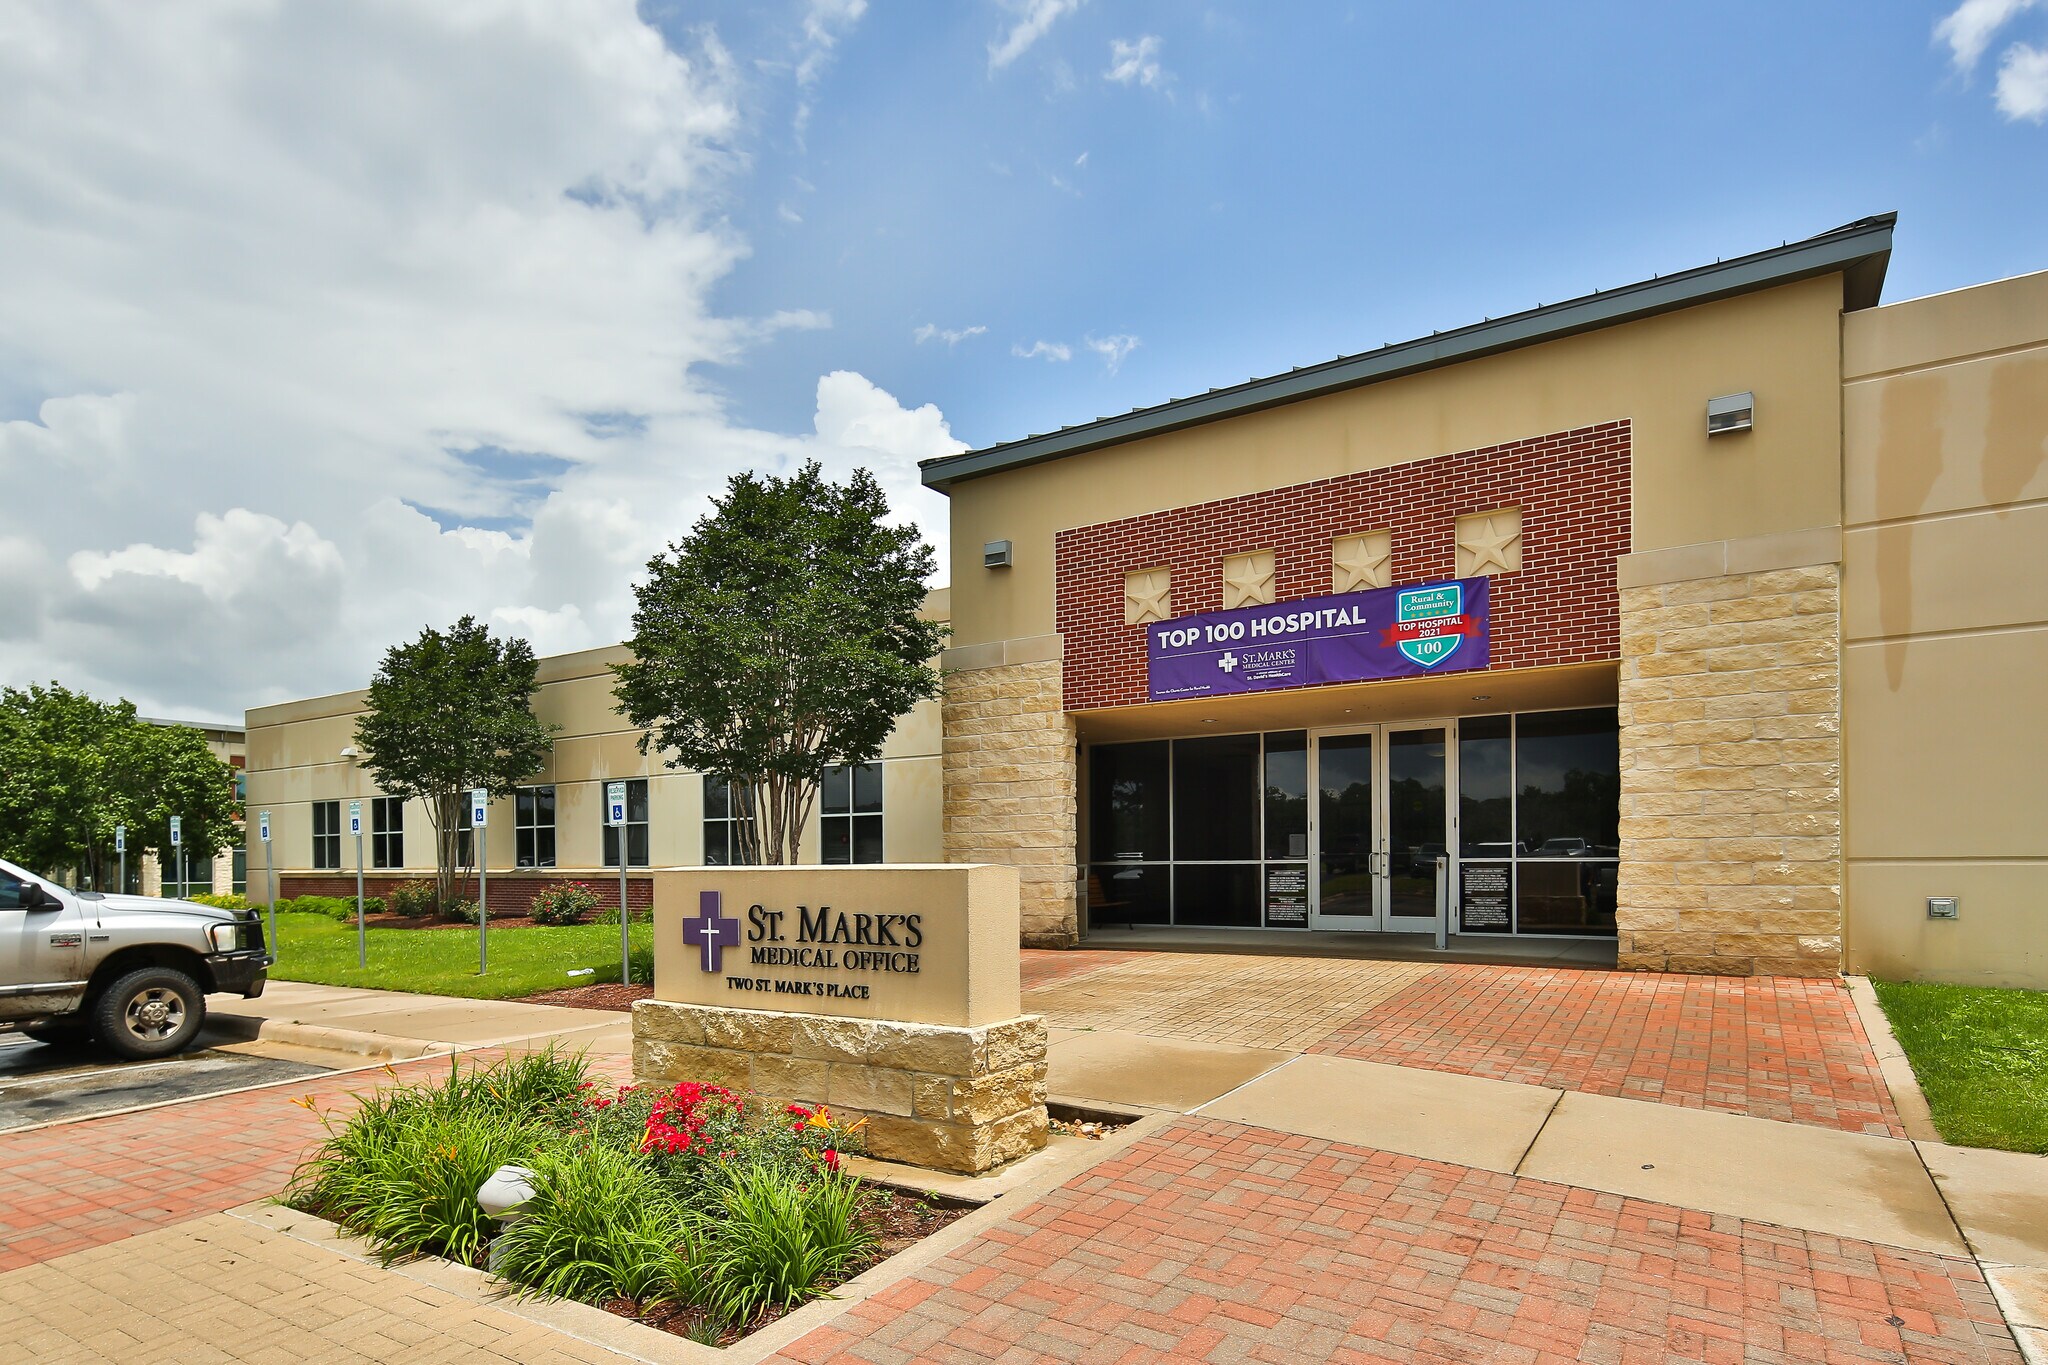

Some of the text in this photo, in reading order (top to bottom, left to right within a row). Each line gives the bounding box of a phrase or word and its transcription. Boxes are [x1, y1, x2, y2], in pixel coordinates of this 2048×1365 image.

[1404, 600, 1454, 612] Community
[1411, 592, 1444, 604] Rural &
[1158, 606, 1366, 650] TOP 100 HOSPITAL
[1398, 616, 1463, 632] TOP HOSPITAL
[1419, 628, 1440, 637] 2021
[1242, 648, 1296, 664] ST. MARK'S
[1416, 641, 1442, 655] 100
[1242, 659, 1296, 670] MEDICAL CENTER
[748, 904, 923, 948] ST. MARK'S
[750, 946, 920, 973] MEDICAL OFFICE
[726, 976, 870, 999] TWO ST. MARK'S PLACE
